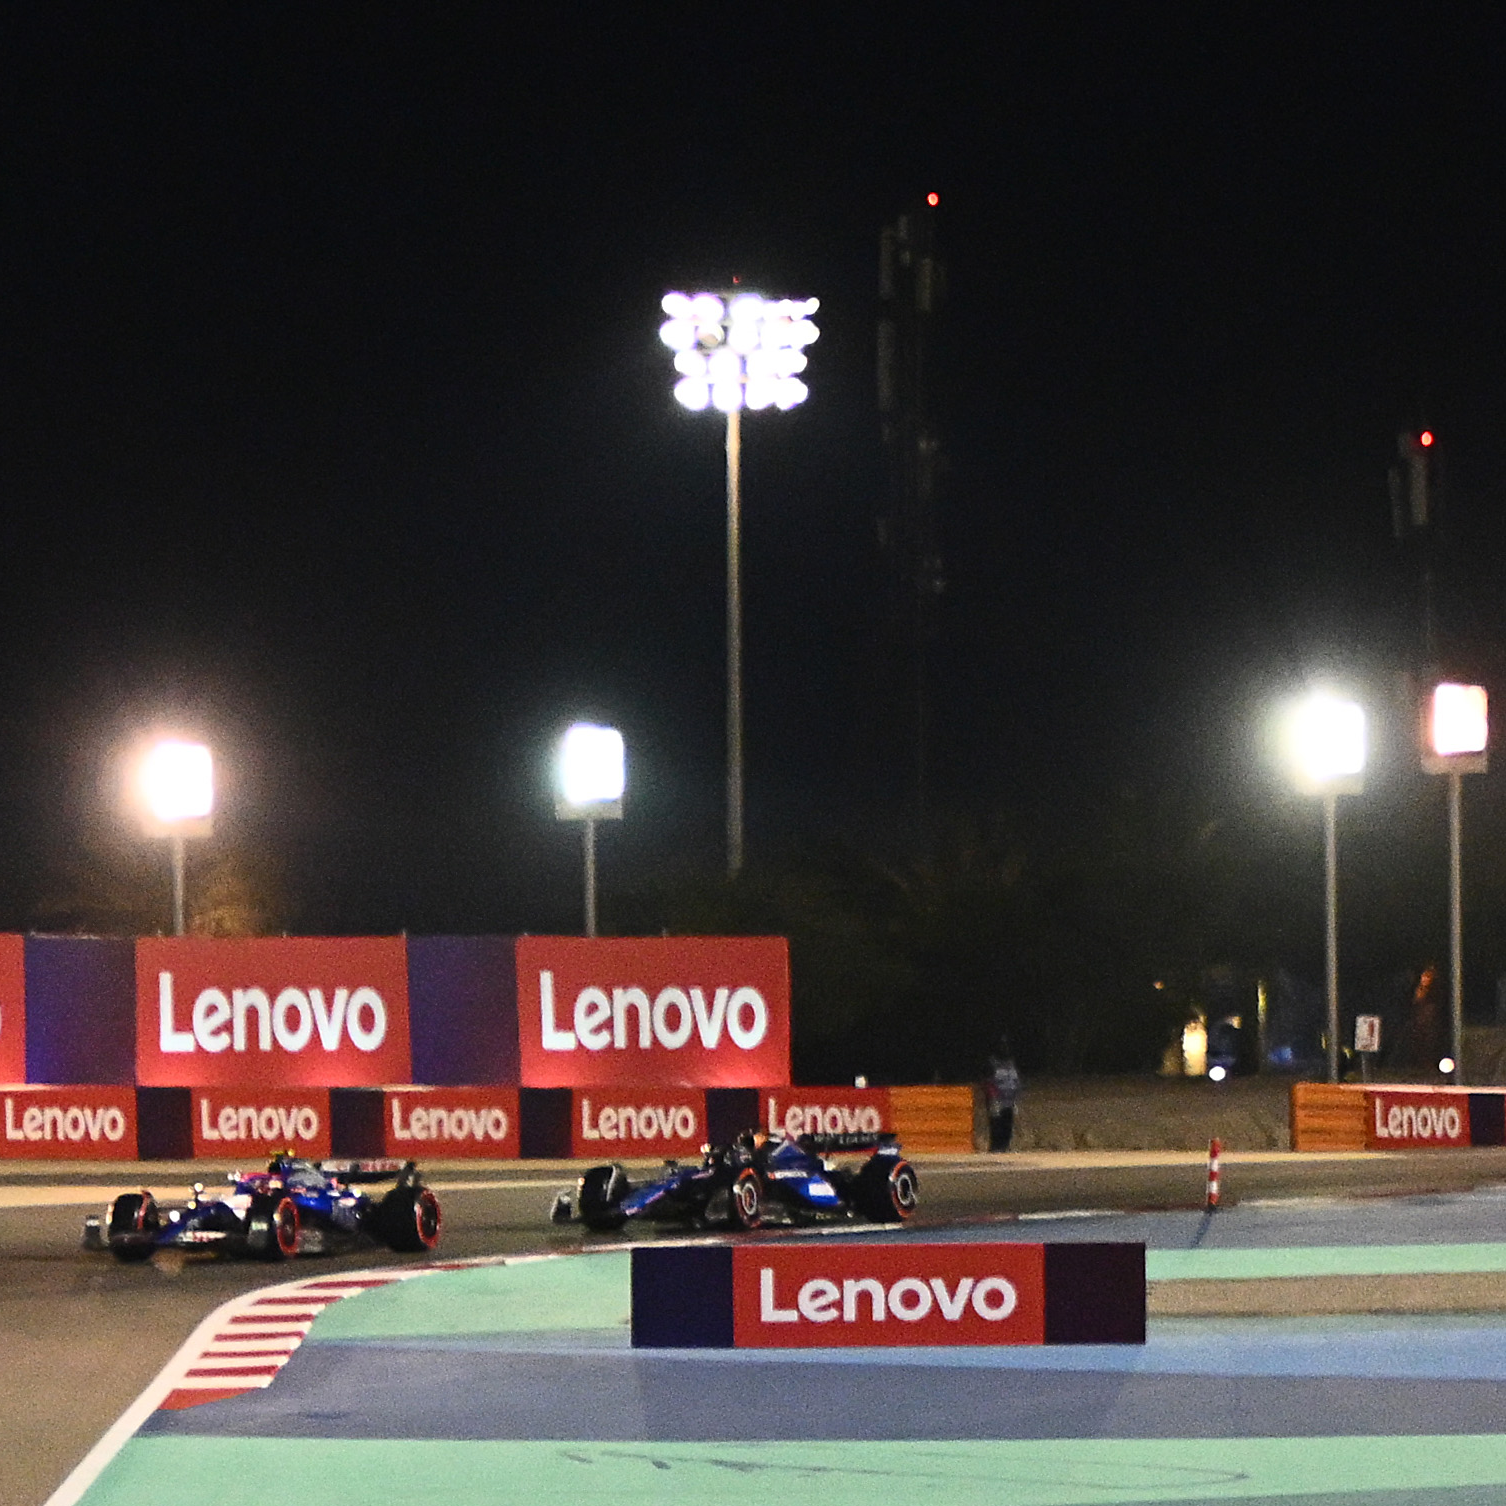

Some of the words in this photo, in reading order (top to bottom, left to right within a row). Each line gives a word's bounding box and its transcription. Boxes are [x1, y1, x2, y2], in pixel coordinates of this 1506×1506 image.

[159, 971, 387, 1052] Lenovo
[540, 971, 767, 1051] Lenovo
[6, 1099, 124, 1140] Lenovo
[201, 1099, 318, 1140] Lenovo
[393, 1099, 507, 1140] Lenovo
[583, 1099, 695, 1139] Lenovo
[768, 1098, 881, 1140] Lenovo
[1375, 1099, 1460, 1138] Lenovo
[761, 1268, 1016, 1322] Lenovo
